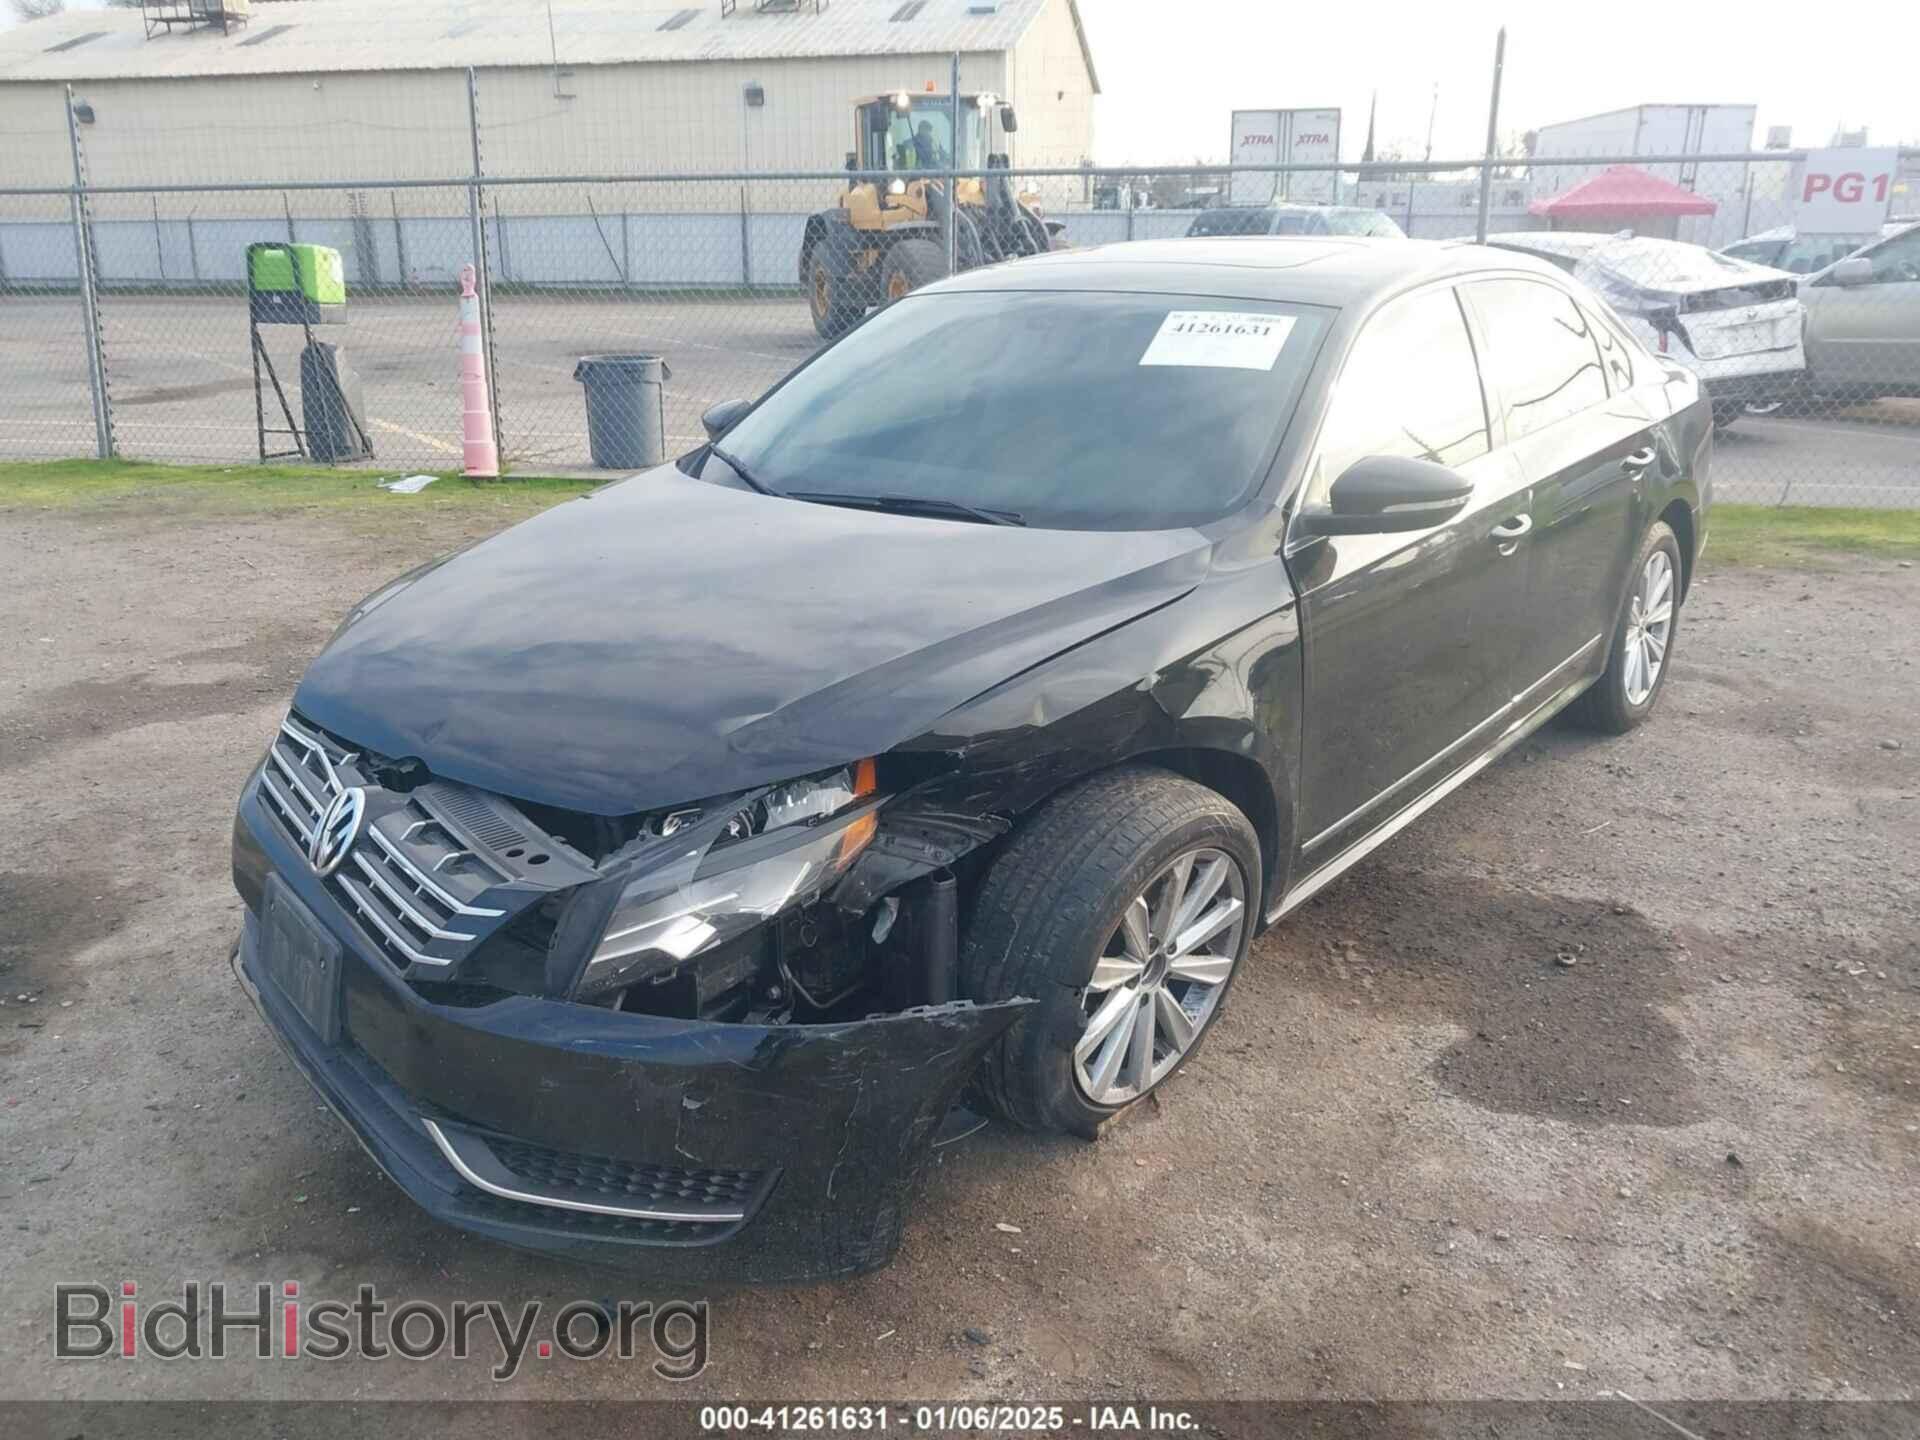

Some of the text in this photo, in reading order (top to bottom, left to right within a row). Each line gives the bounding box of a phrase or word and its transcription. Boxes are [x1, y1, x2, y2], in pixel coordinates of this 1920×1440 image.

[1241, 134, 1273, 147] XTRA
[1295, 133, 1329, 146] XTRA
[1801, 172, 1889, 203] PG1
[1173, 322, 1271, 337] 41261631
